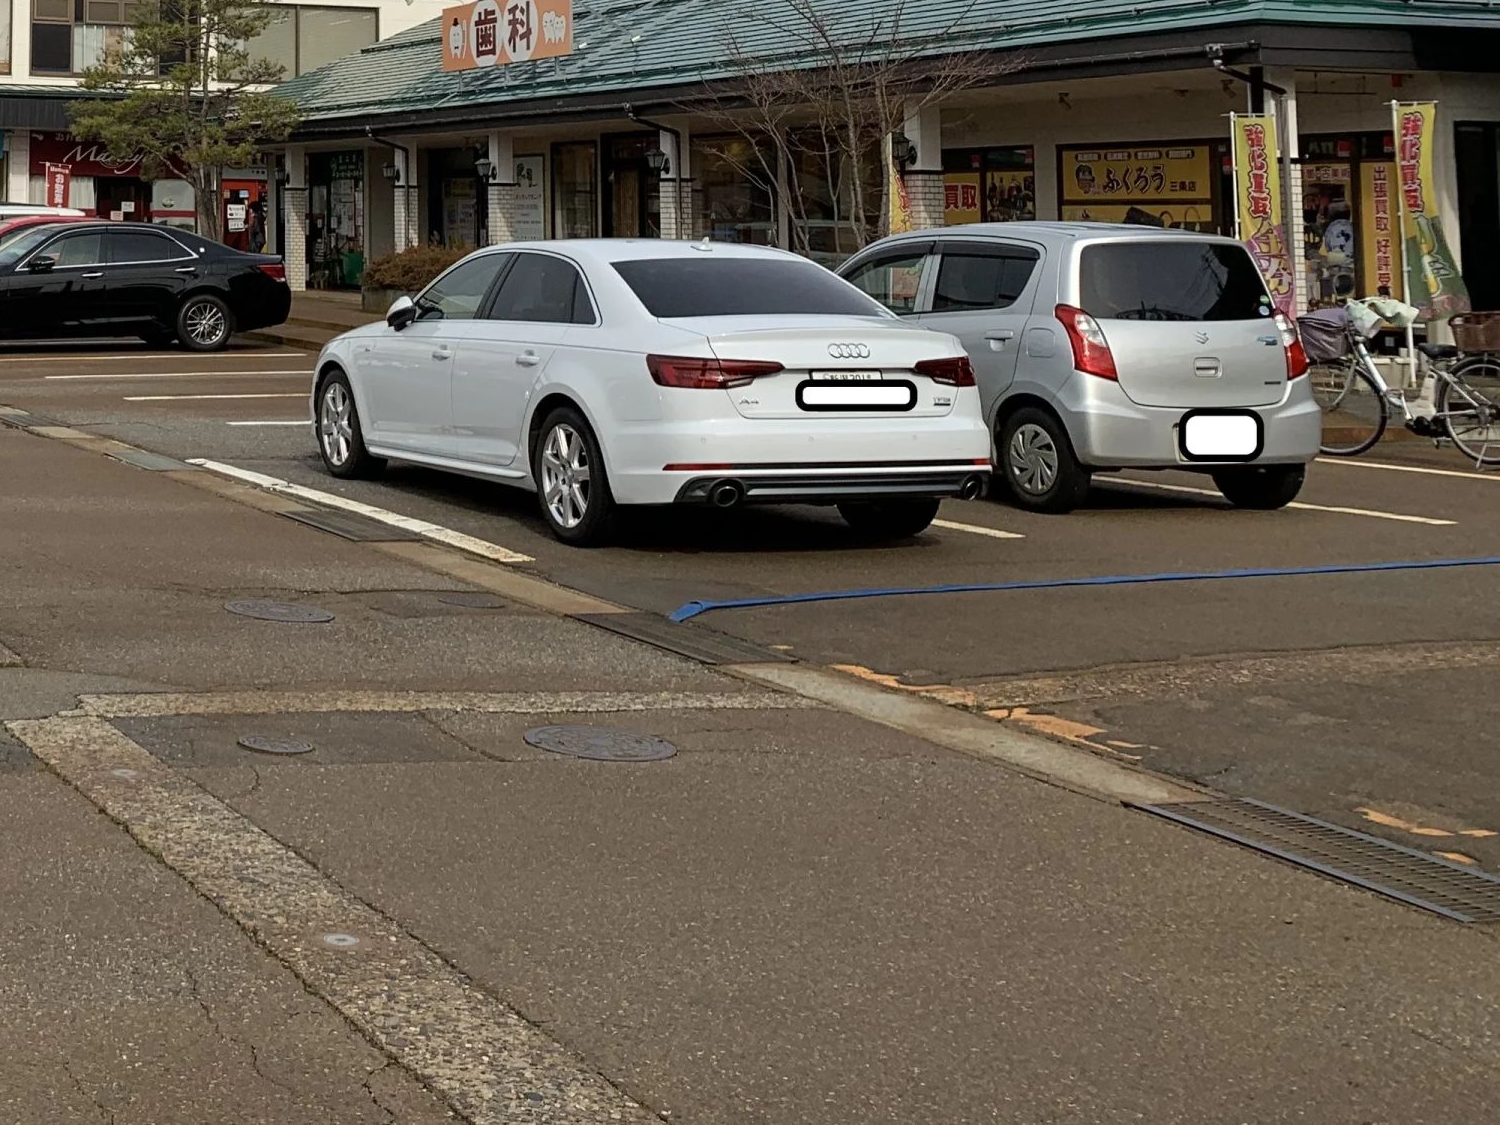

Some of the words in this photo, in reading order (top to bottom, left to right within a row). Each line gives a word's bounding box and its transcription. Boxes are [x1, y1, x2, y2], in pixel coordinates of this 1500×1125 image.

[474, 1, 532, 58] 歯科
[943, 183, 978, 211] 買取
[1102, 164, 1167, 194] ふくろう
[1169, 181, 1197, 192] 三条店
[1373, 166, 1390, 231] 出張買取
